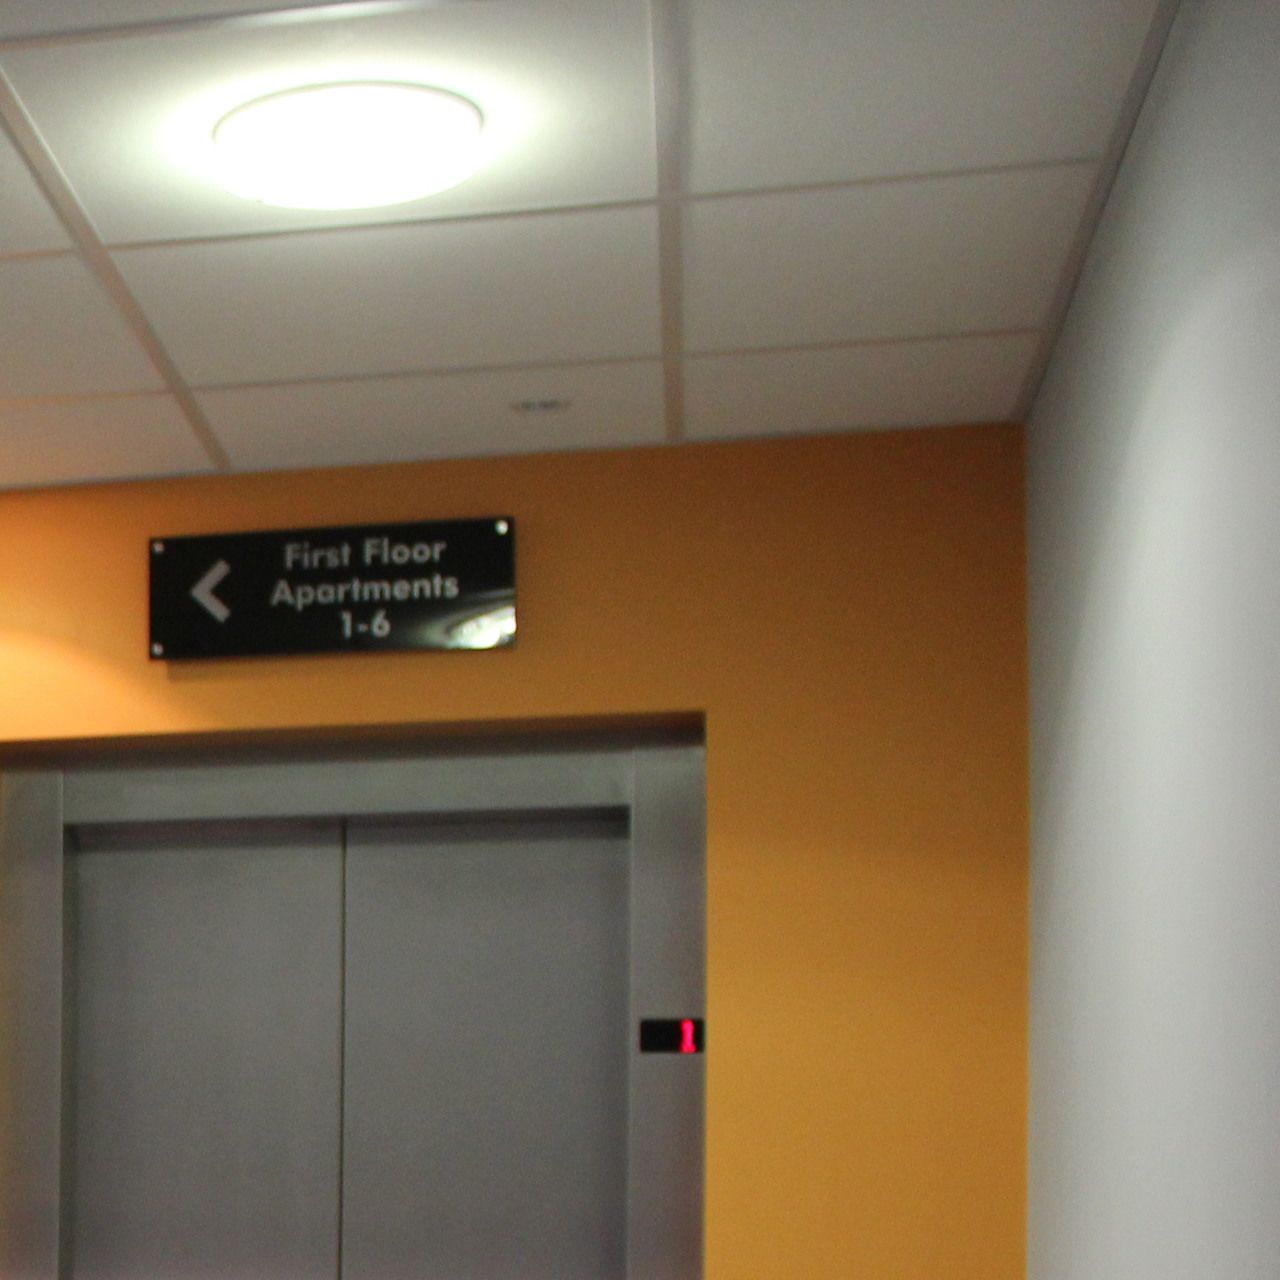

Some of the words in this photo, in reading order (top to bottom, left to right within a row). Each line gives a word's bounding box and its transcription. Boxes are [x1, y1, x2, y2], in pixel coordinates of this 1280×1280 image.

[285, 541, 351, 571] First
[363, 536, 446, 566] Floor
[270, 573, 459, 610] Apartments
[340, 611, 391, 639] 1-6
[680, 1018, 697, 1053] 1
